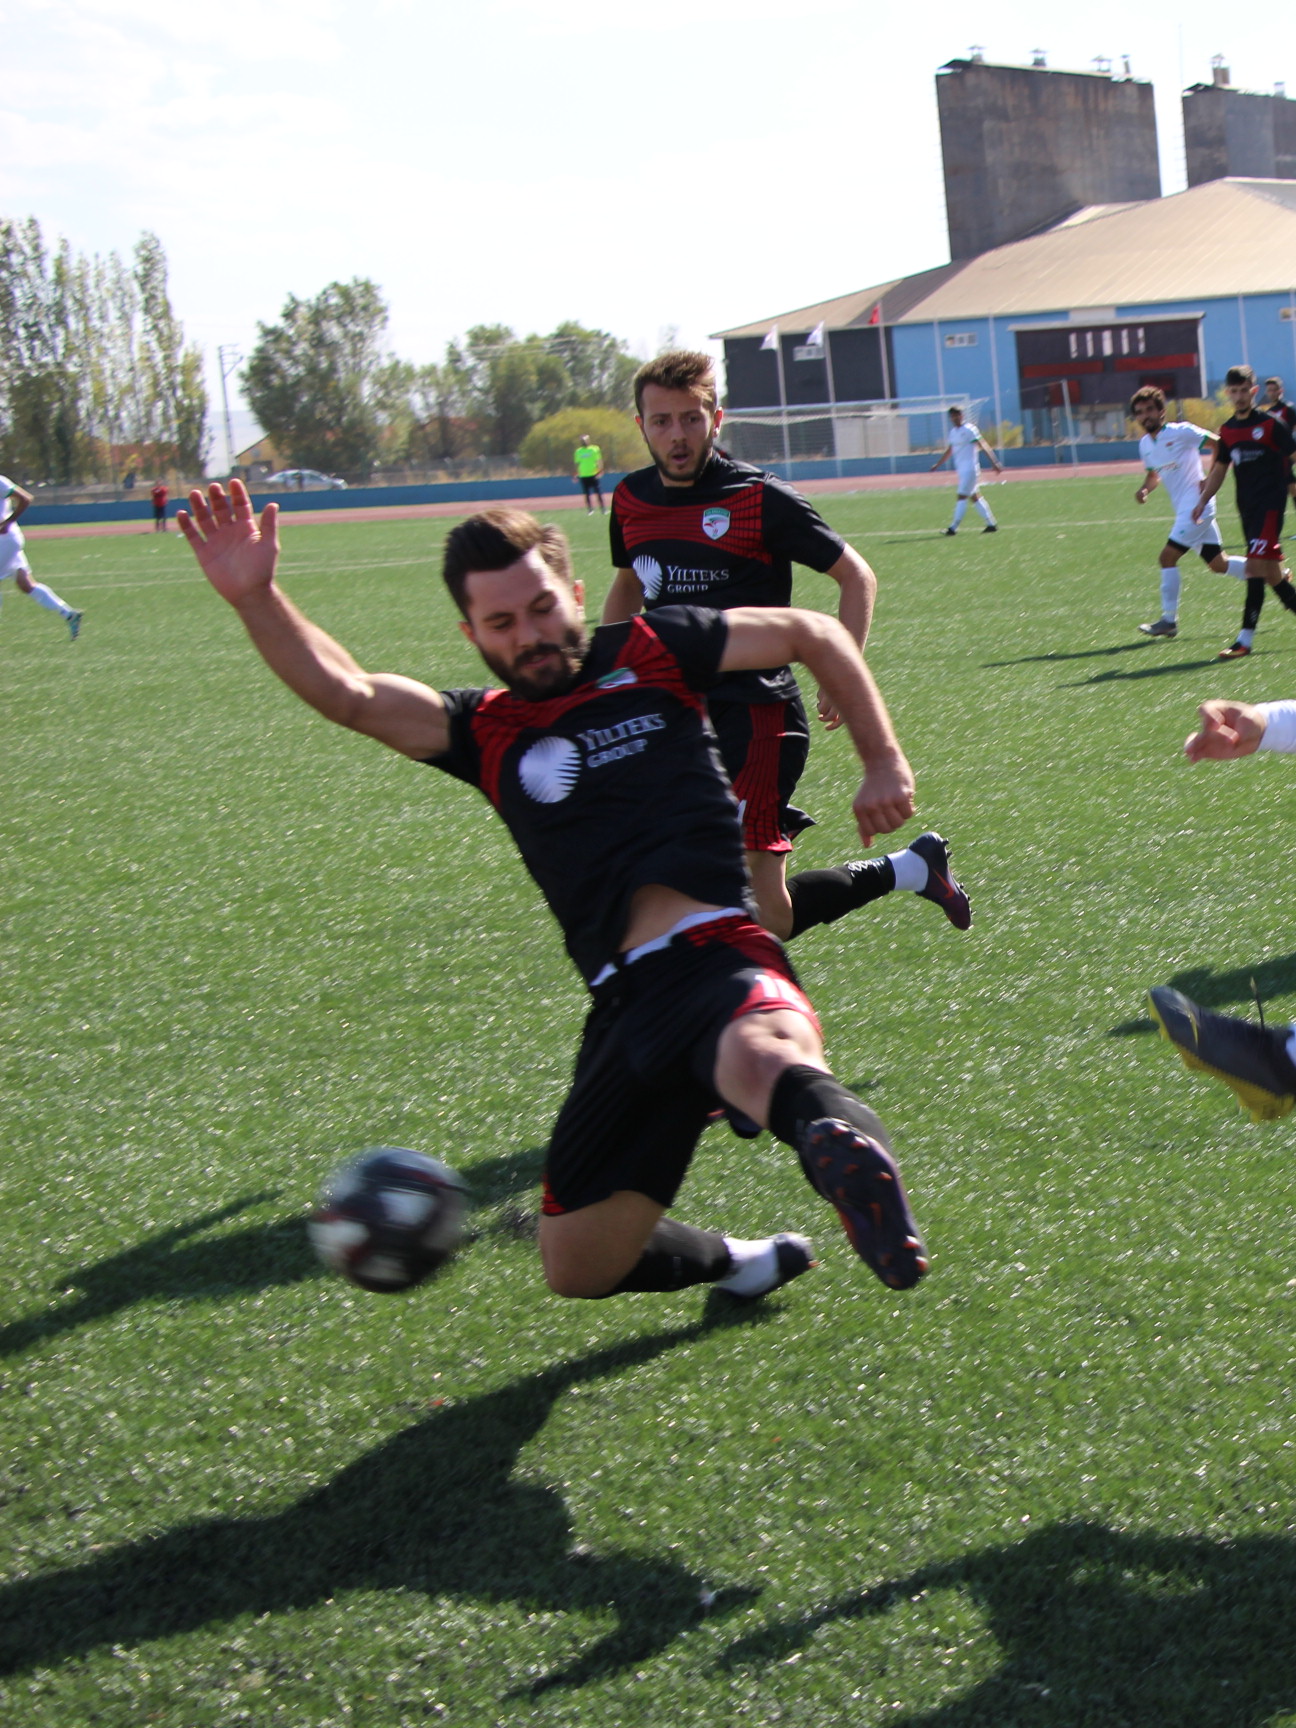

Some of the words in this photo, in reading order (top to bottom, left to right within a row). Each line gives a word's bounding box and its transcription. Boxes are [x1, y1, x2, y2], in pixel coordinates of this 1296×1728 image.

[1249, 538, 1268, 555] 72
[666, 565, 730, 582] YILTEKS
[667, 583, 709, 594] GROUP
[577, 713, 667, 751] YILTEKS
[587, 739, 648, 768] GROUP
